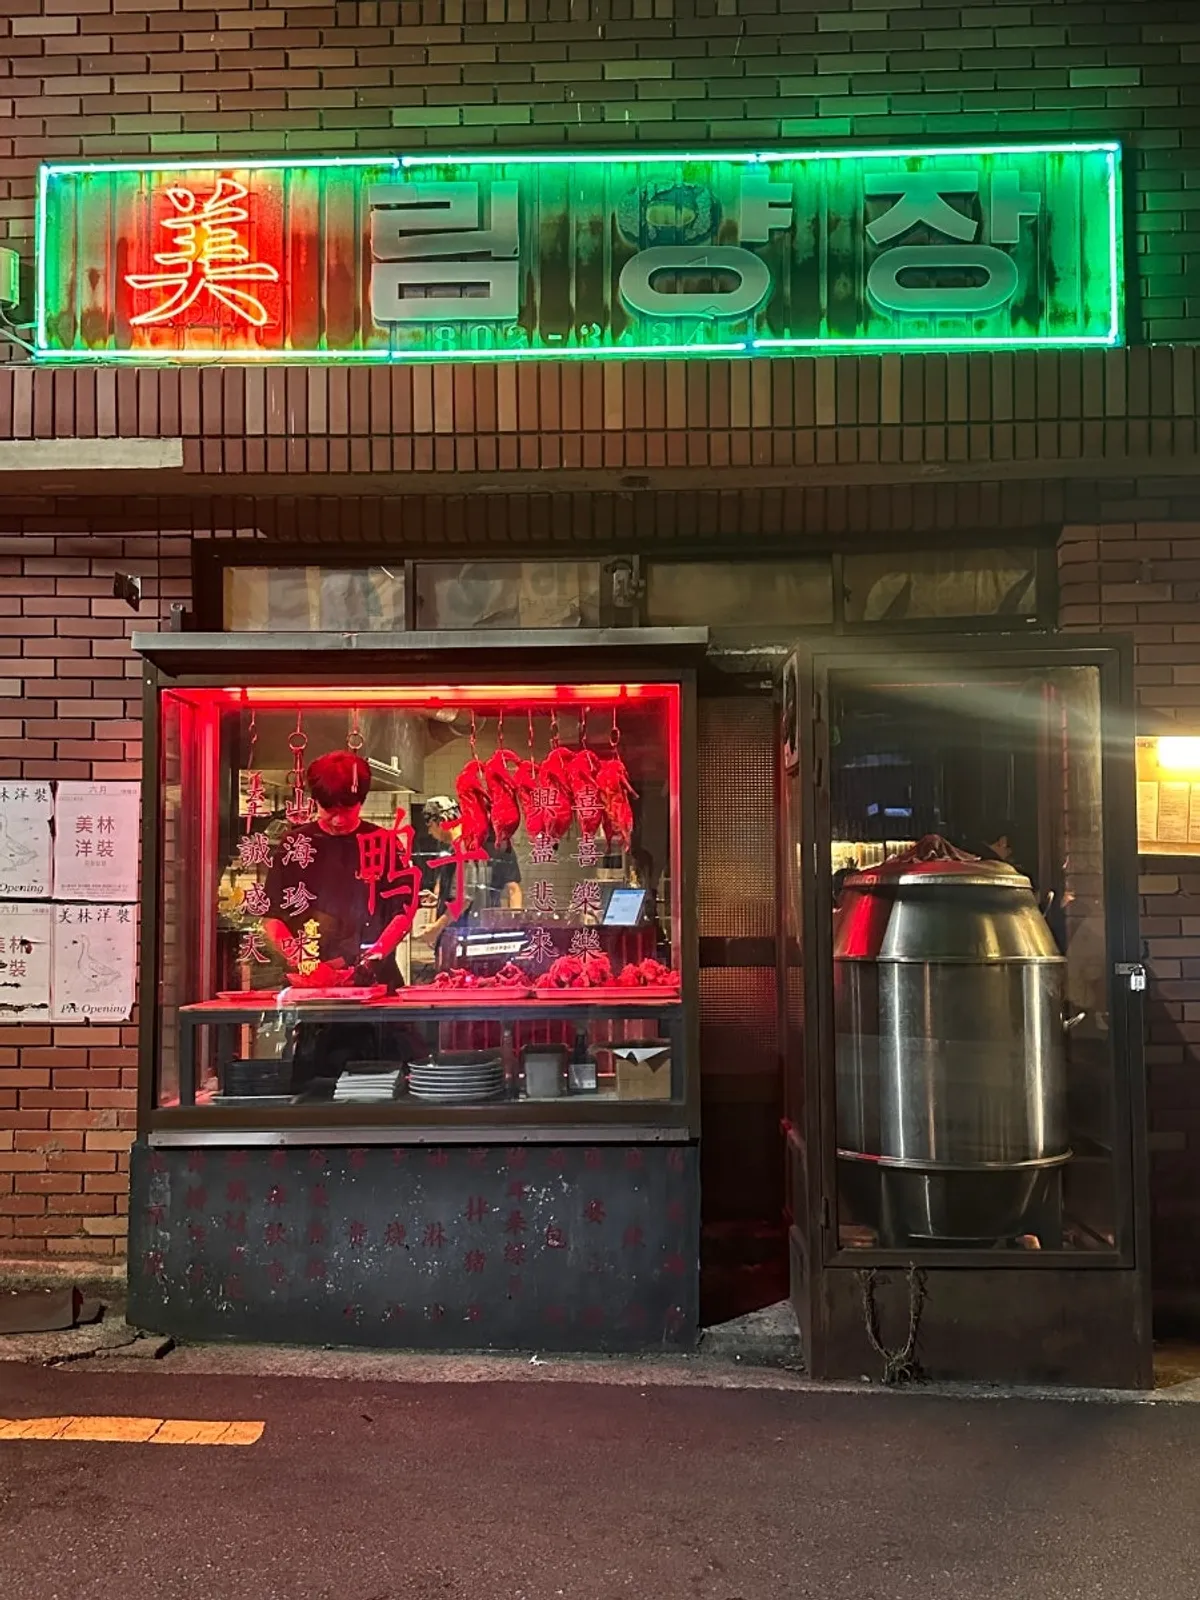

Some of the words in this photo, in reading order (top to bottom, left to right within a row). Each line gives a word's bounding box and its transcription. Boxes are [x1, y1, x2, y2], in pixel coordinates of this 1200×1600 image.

[124, 178, 279, 326] 美
[75, 815, 116, 834] 美林
[75, 839, 115, 857] 洋裝
[281, 788, 319, 964] 山海珍味
[571, 786, 604, 962] 喜喜樂樂
[81, 1004, 127, 1015] Opening
